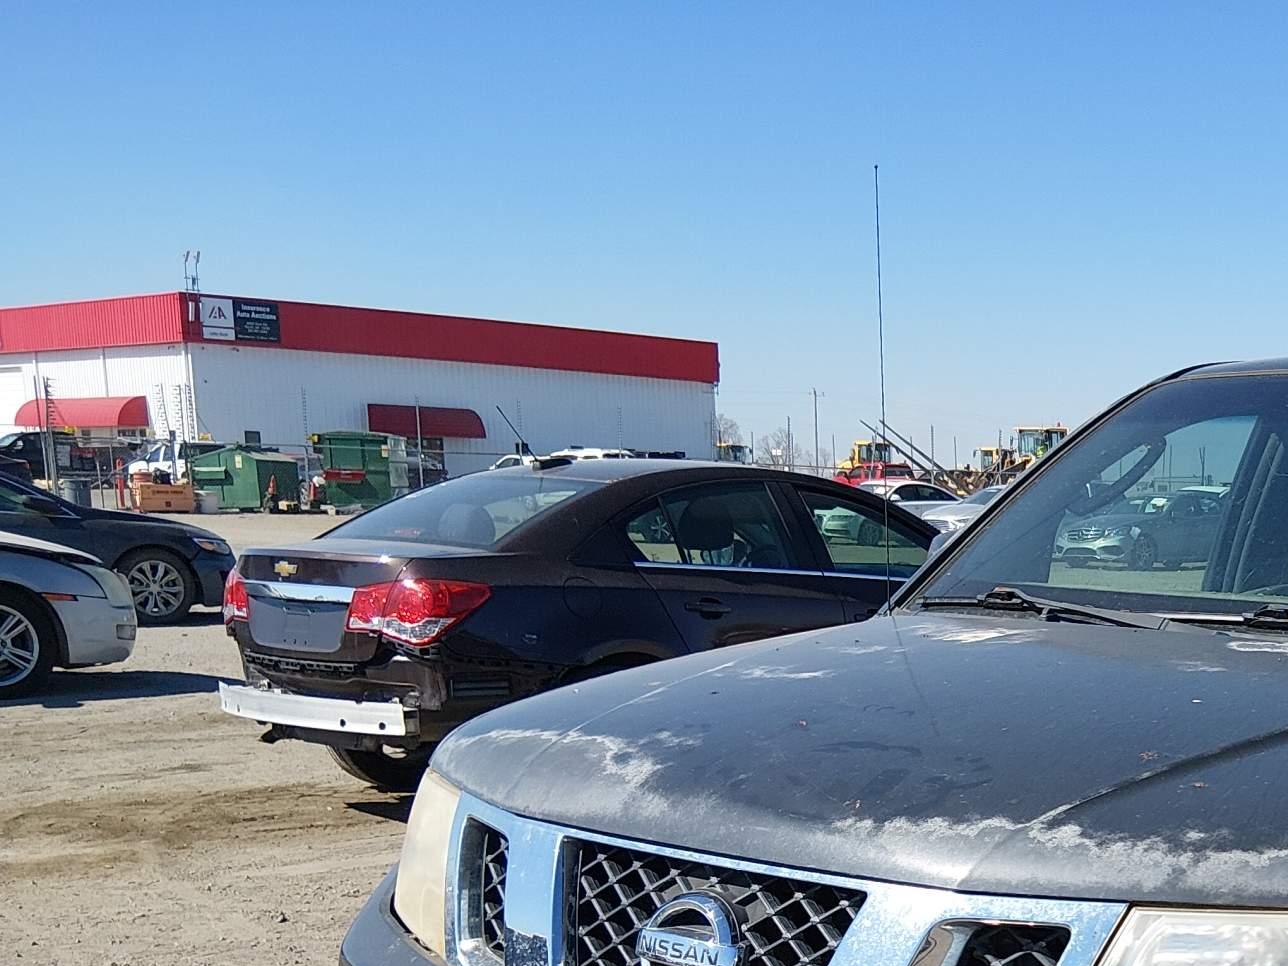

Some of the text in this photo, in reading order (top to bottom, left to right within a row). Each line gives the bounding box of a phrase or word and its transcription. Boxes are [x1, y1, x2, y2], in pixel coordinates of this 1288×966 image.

[241, 303, 270, 312] Insurance
[251, 311, 277, 320] Auctions
[640, 933, 720, 966] NISSAN
